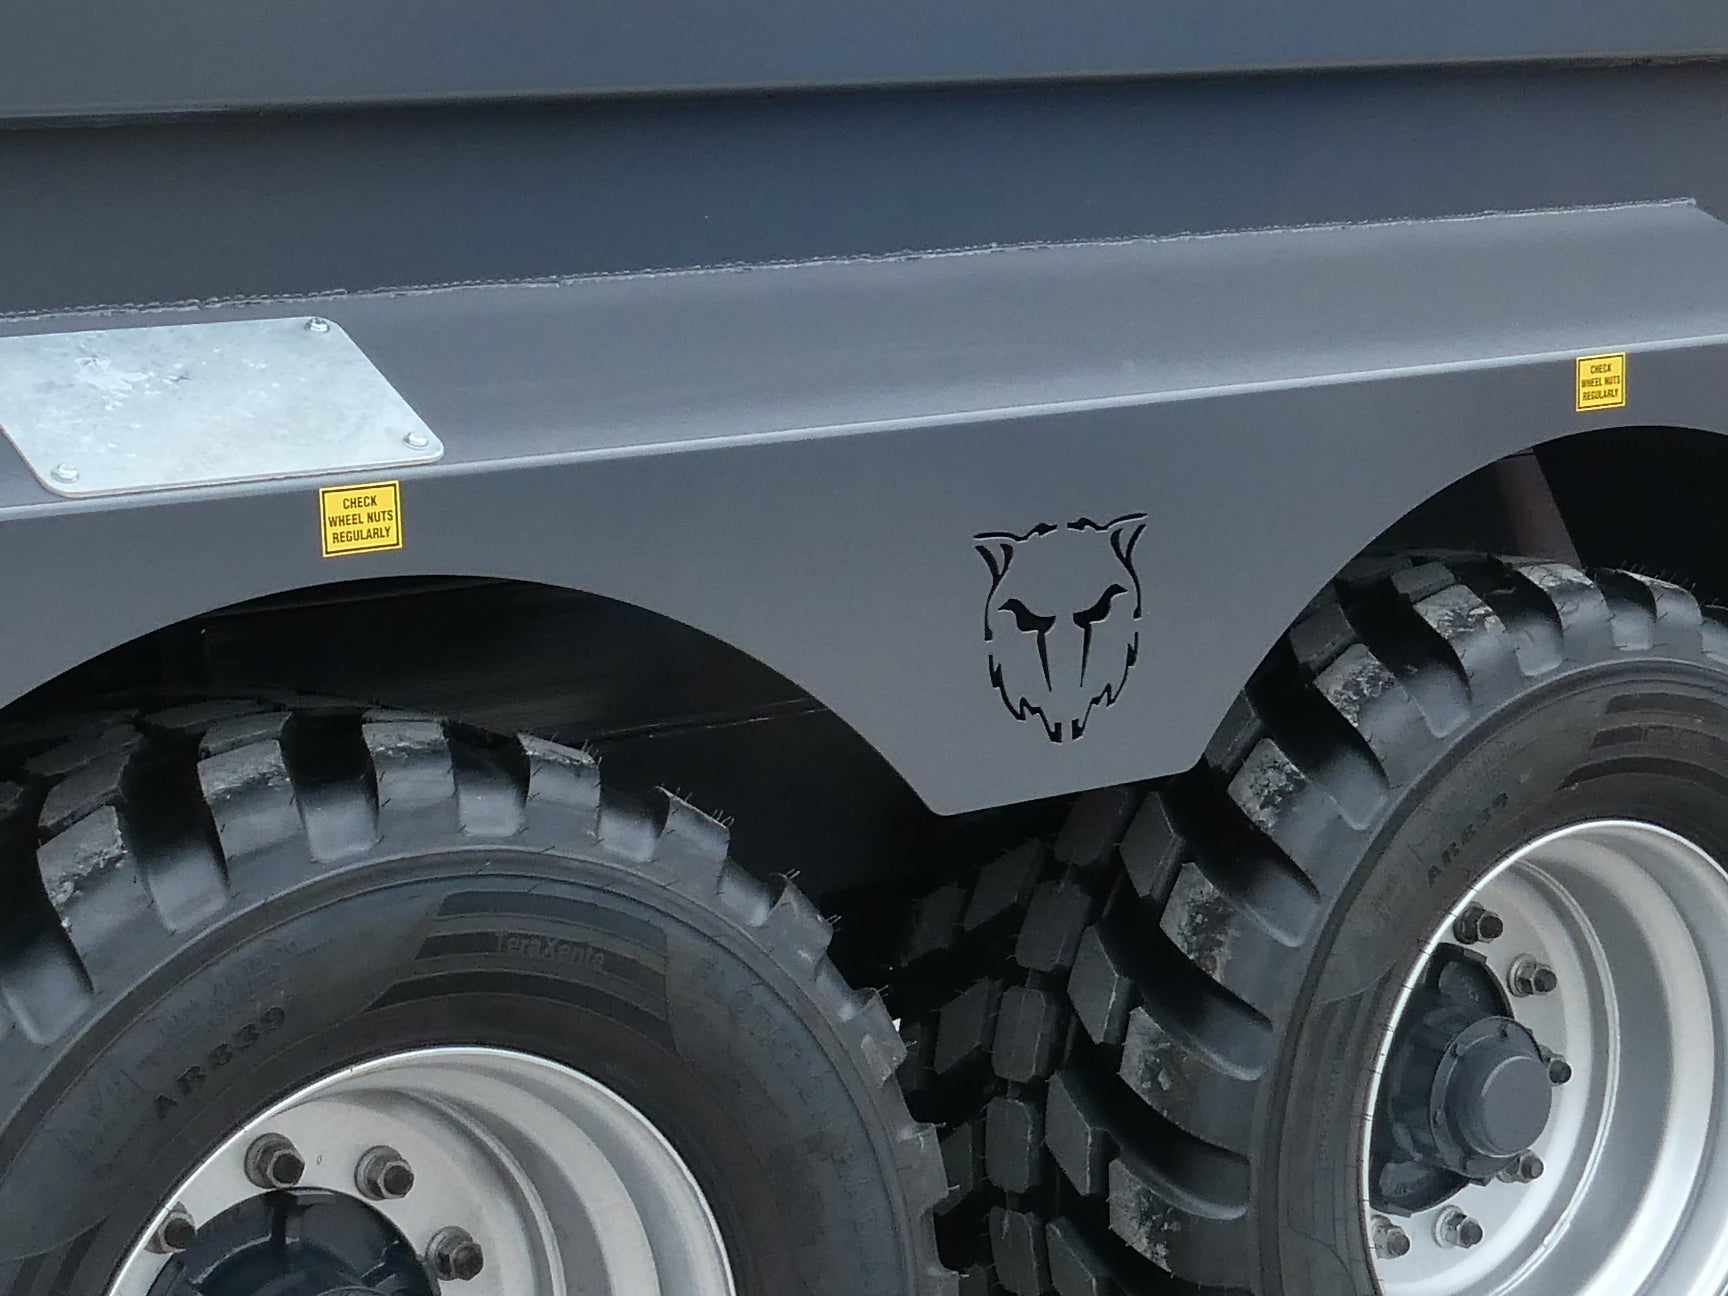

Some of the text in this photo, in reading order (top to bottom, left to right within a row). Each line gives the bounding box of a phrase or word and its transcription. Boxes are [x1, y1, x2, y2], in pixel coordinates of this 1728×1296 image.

[342, 495, 378, 510] CHECK
[328, 509, 394, 527] WHEEL NUTS
[332, 526, 391, 544] REGULARLY
